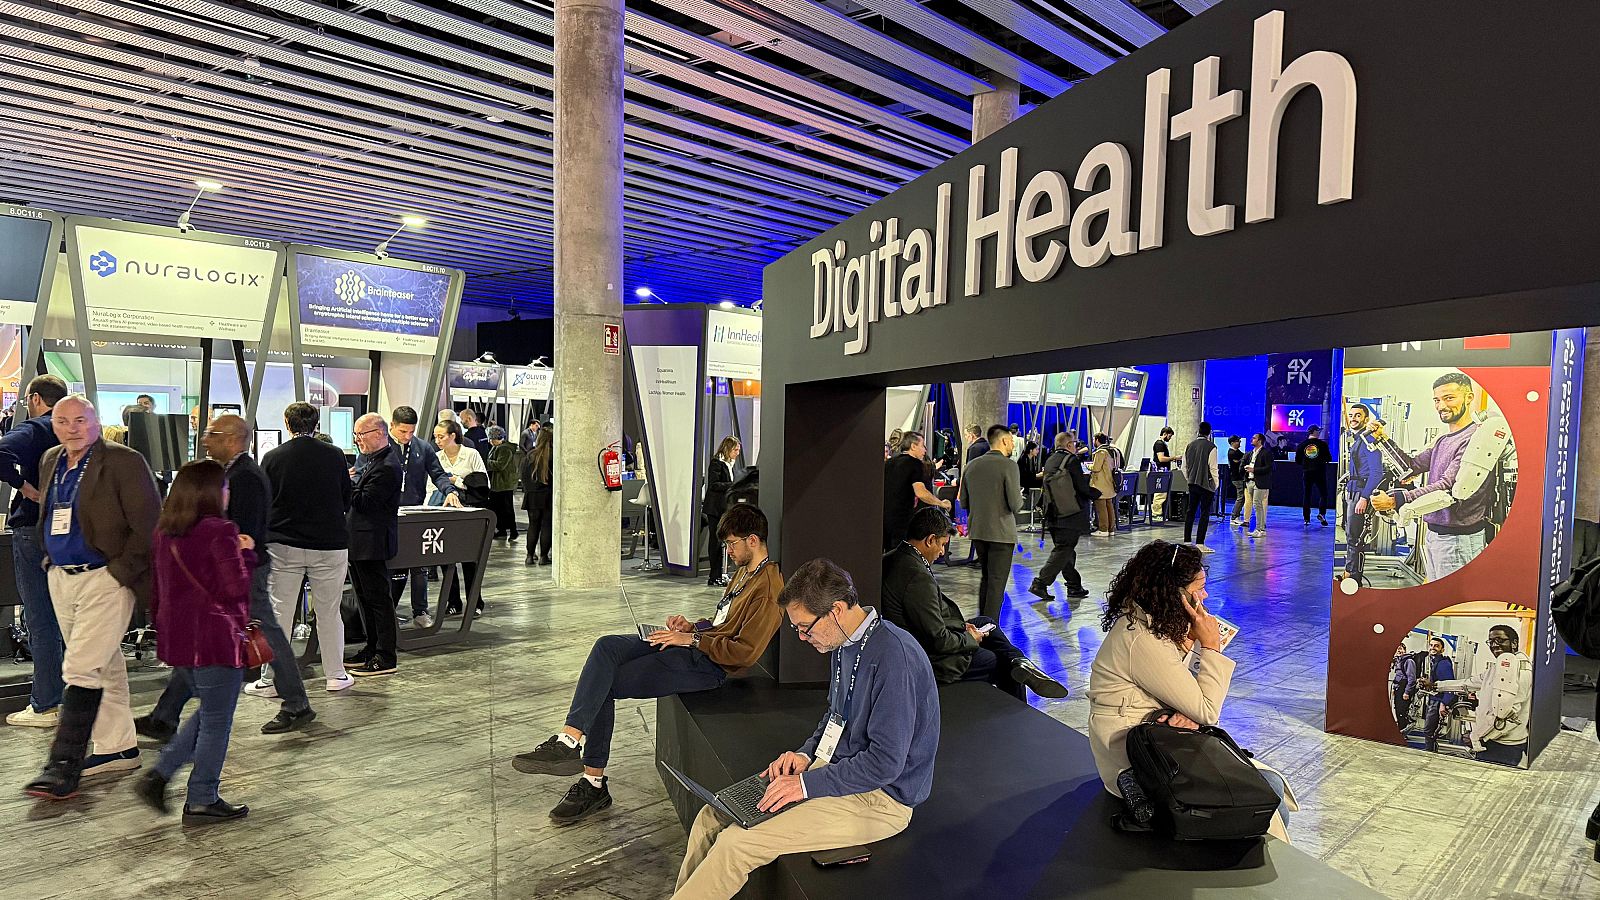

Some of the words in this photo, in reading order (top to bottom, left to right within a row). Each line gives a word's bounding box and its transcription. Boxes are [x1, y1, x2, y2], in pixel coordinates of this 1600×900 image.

[809, 182, 951, 356] Digital
[964, 9, 1358, 298] Health
[9, 207, 43, 219] 8.0C11.6
[244, 239, 271, 249] 8.0C11.8
[367, 286, 415, 301] Brainteaser
[122, 312, 155, 321] Corporation
[1563, 338, 1571, 376] for
[1287, 358, 1313, 372] 4Y
[525, 373, 547, 381] OLIVER
[1286, 371, 1312, 385] FN
[1288, 409, 1305, 418] 4Y
[1561, 339, 1576, 490] AI-powered
[1287, 417, 1304, 427] FN
[1556, 383, 1568, 478] Patient
[421, 527, 445, 541] 4Y
[422, 540, 444, 555] FN
